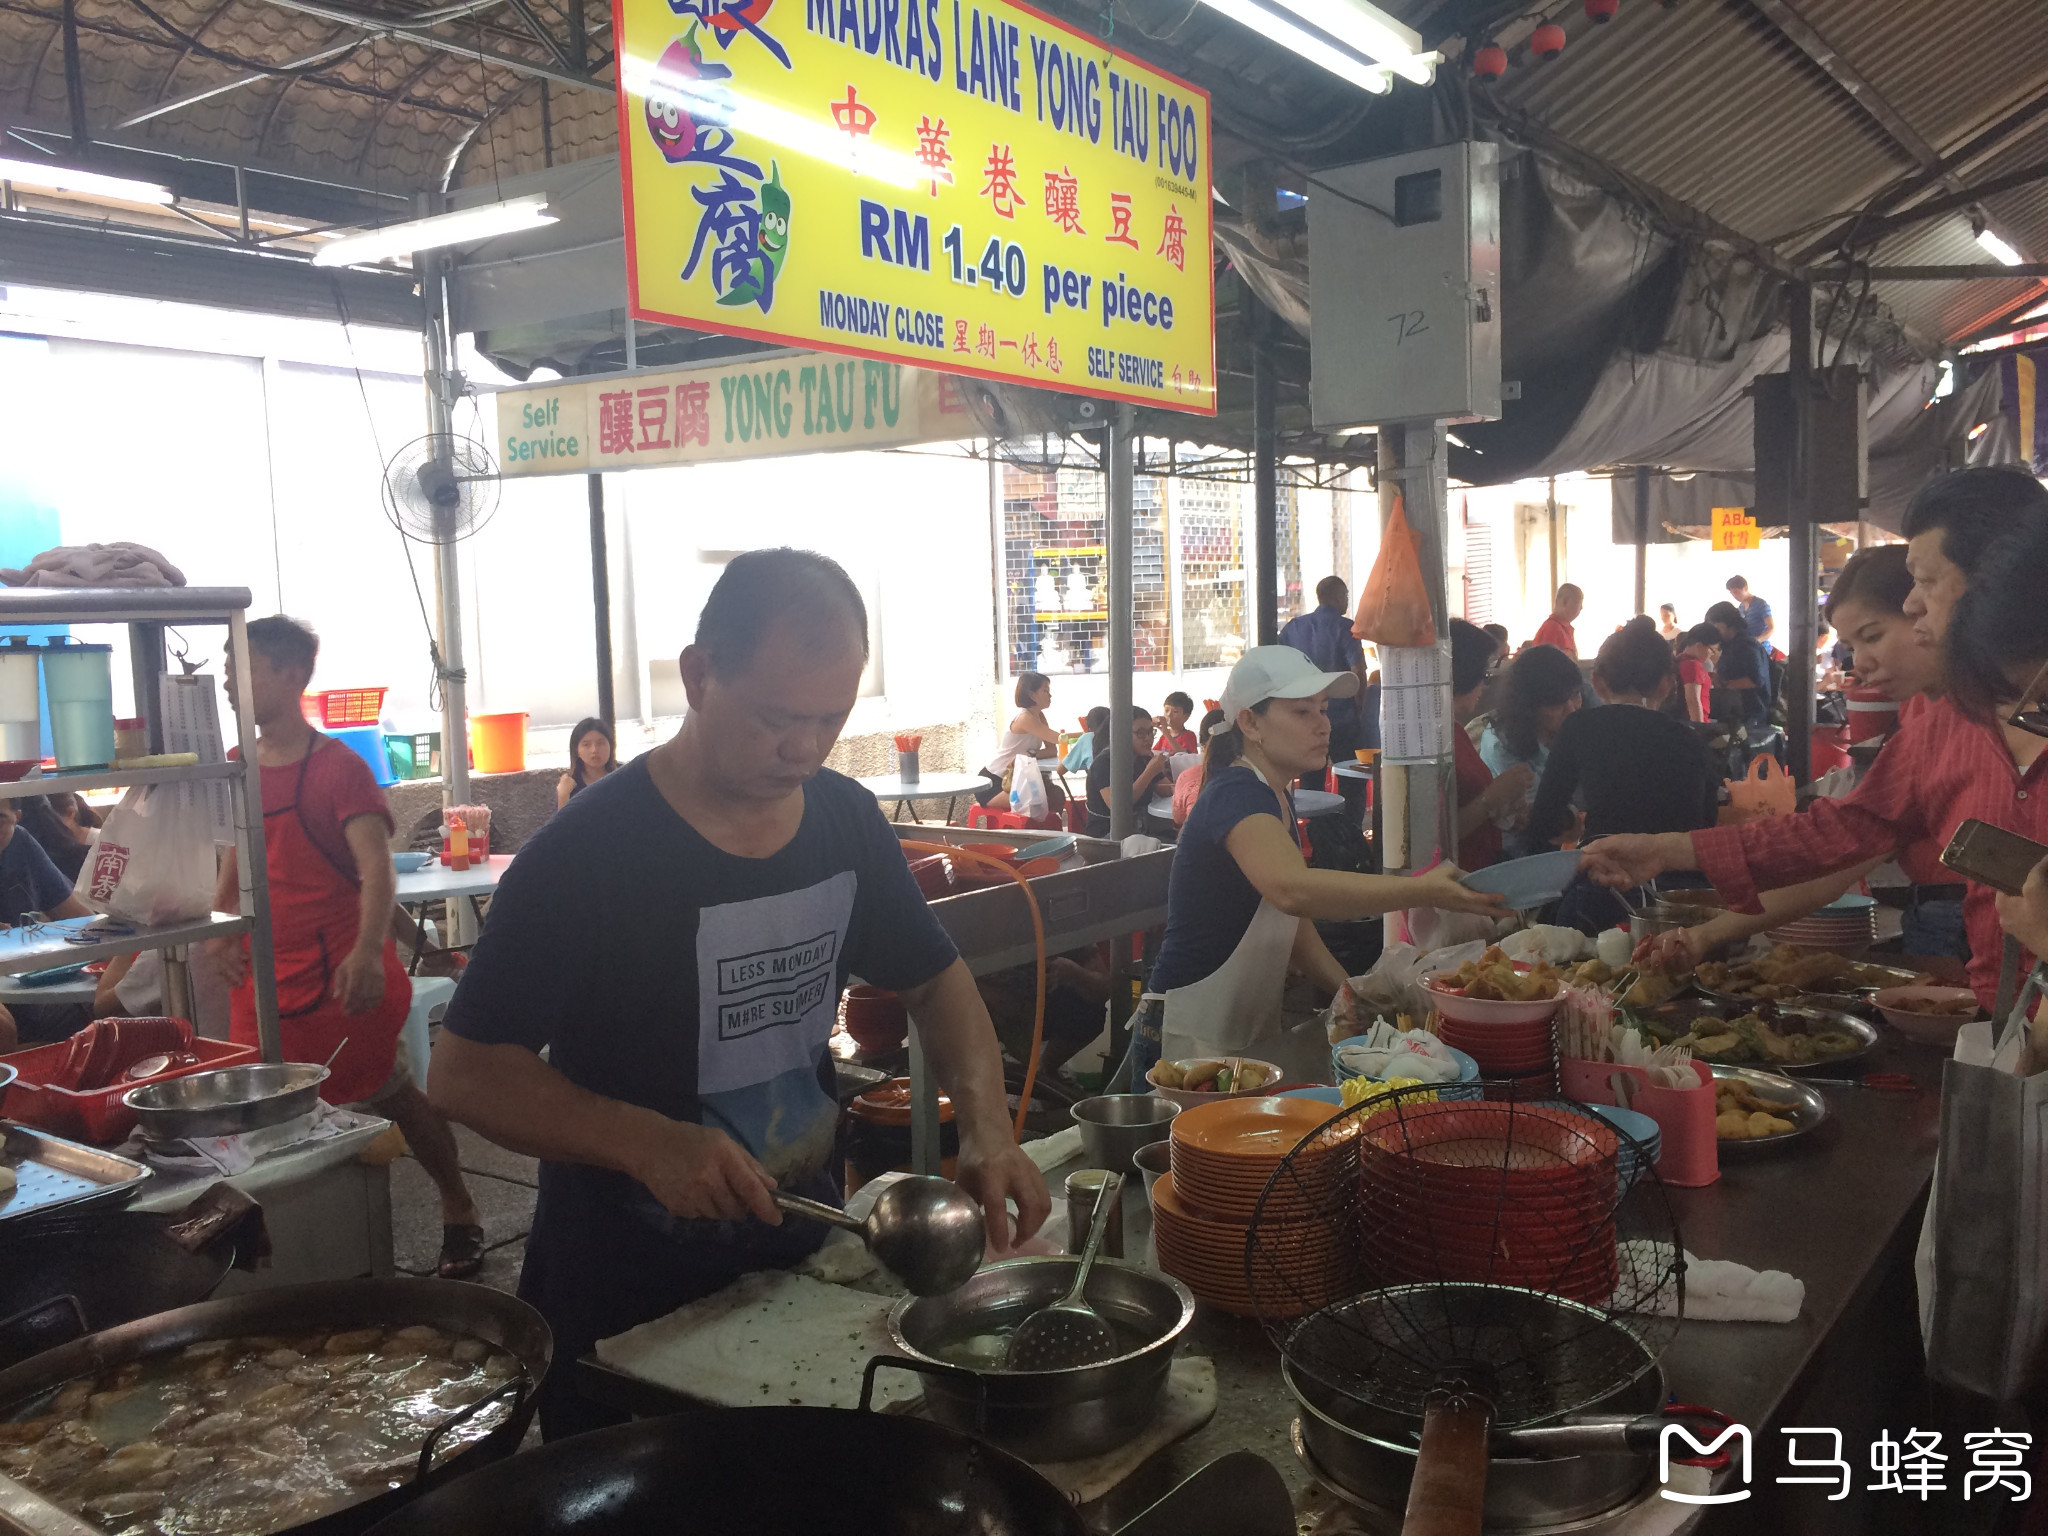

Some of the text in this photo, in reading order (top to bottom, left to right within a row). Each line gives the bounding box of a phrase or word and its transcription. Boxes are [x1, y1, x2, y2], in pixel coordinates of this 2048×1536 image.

[954, 1, 1020, 112] LANE
[1031, 35, 1100, 144] YONG
[1109, 72, 1148, 162] TAU
[1158, 94, 1197, 182] FOO
[665, 0, 792, 315] 豆腐
[860, 199, 1173, 330] RM 1.40 per piece
[820, 290, 890, 338] MONDAY
[895, 307, 944, 348] CLOSE
[953, 320, 1063, 374] 星期一休息
[1088, 346, 1115, 379] SELF
[1119, 353, 1164, 389] SERVICE
[1387, 310, 1430, 346] 72
[523, 398, 559, 429] Self
[599, 381, 710, 455] 釀豆腐
[720, 369, 793, 444] YONG
[799, 361, 856, 436] TAU
[862, 360, 901, 429] FU
[508, 431, 579, 462] Service
[1722, 513, 1751, 526] ABC
[731, 942, 828, 984] LESS MONDAY
